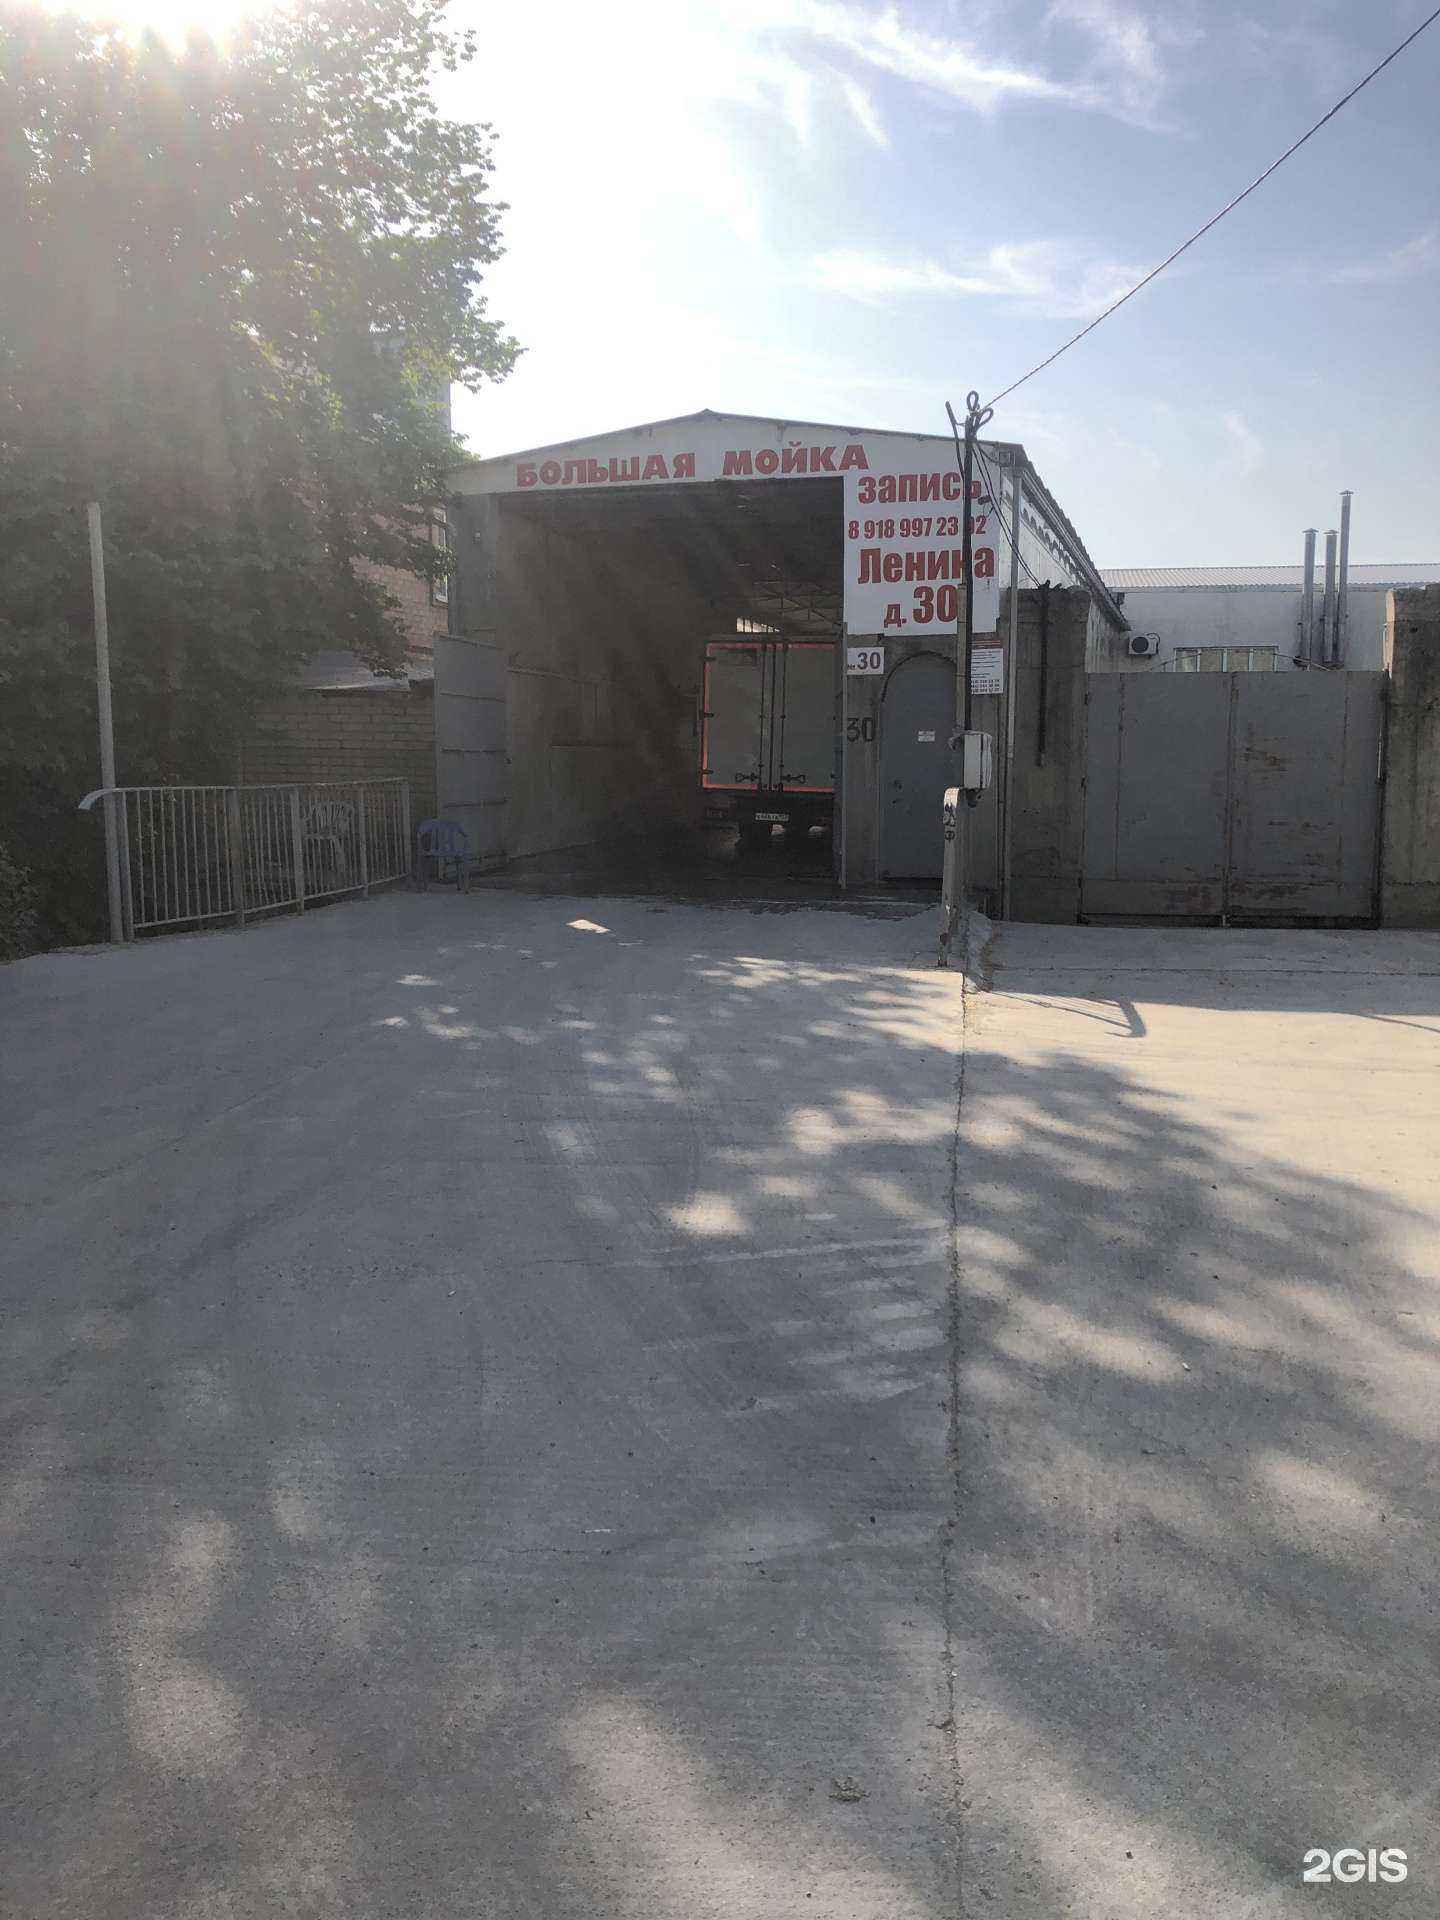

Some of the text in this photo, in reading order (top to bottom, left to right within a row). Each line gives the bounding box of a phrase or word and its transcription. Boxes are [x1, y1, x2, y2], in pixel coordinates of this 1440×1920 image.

[517, 441, 869, 487] БОЛЬШАЯ МОЙКА
[848, 520, 860, 539] 8
[864, 519, 895, 539] 918
[900, 517, 933, 537] 997
[936, 516, 959, 536] 23
[913, 585, 958, 624] 30
